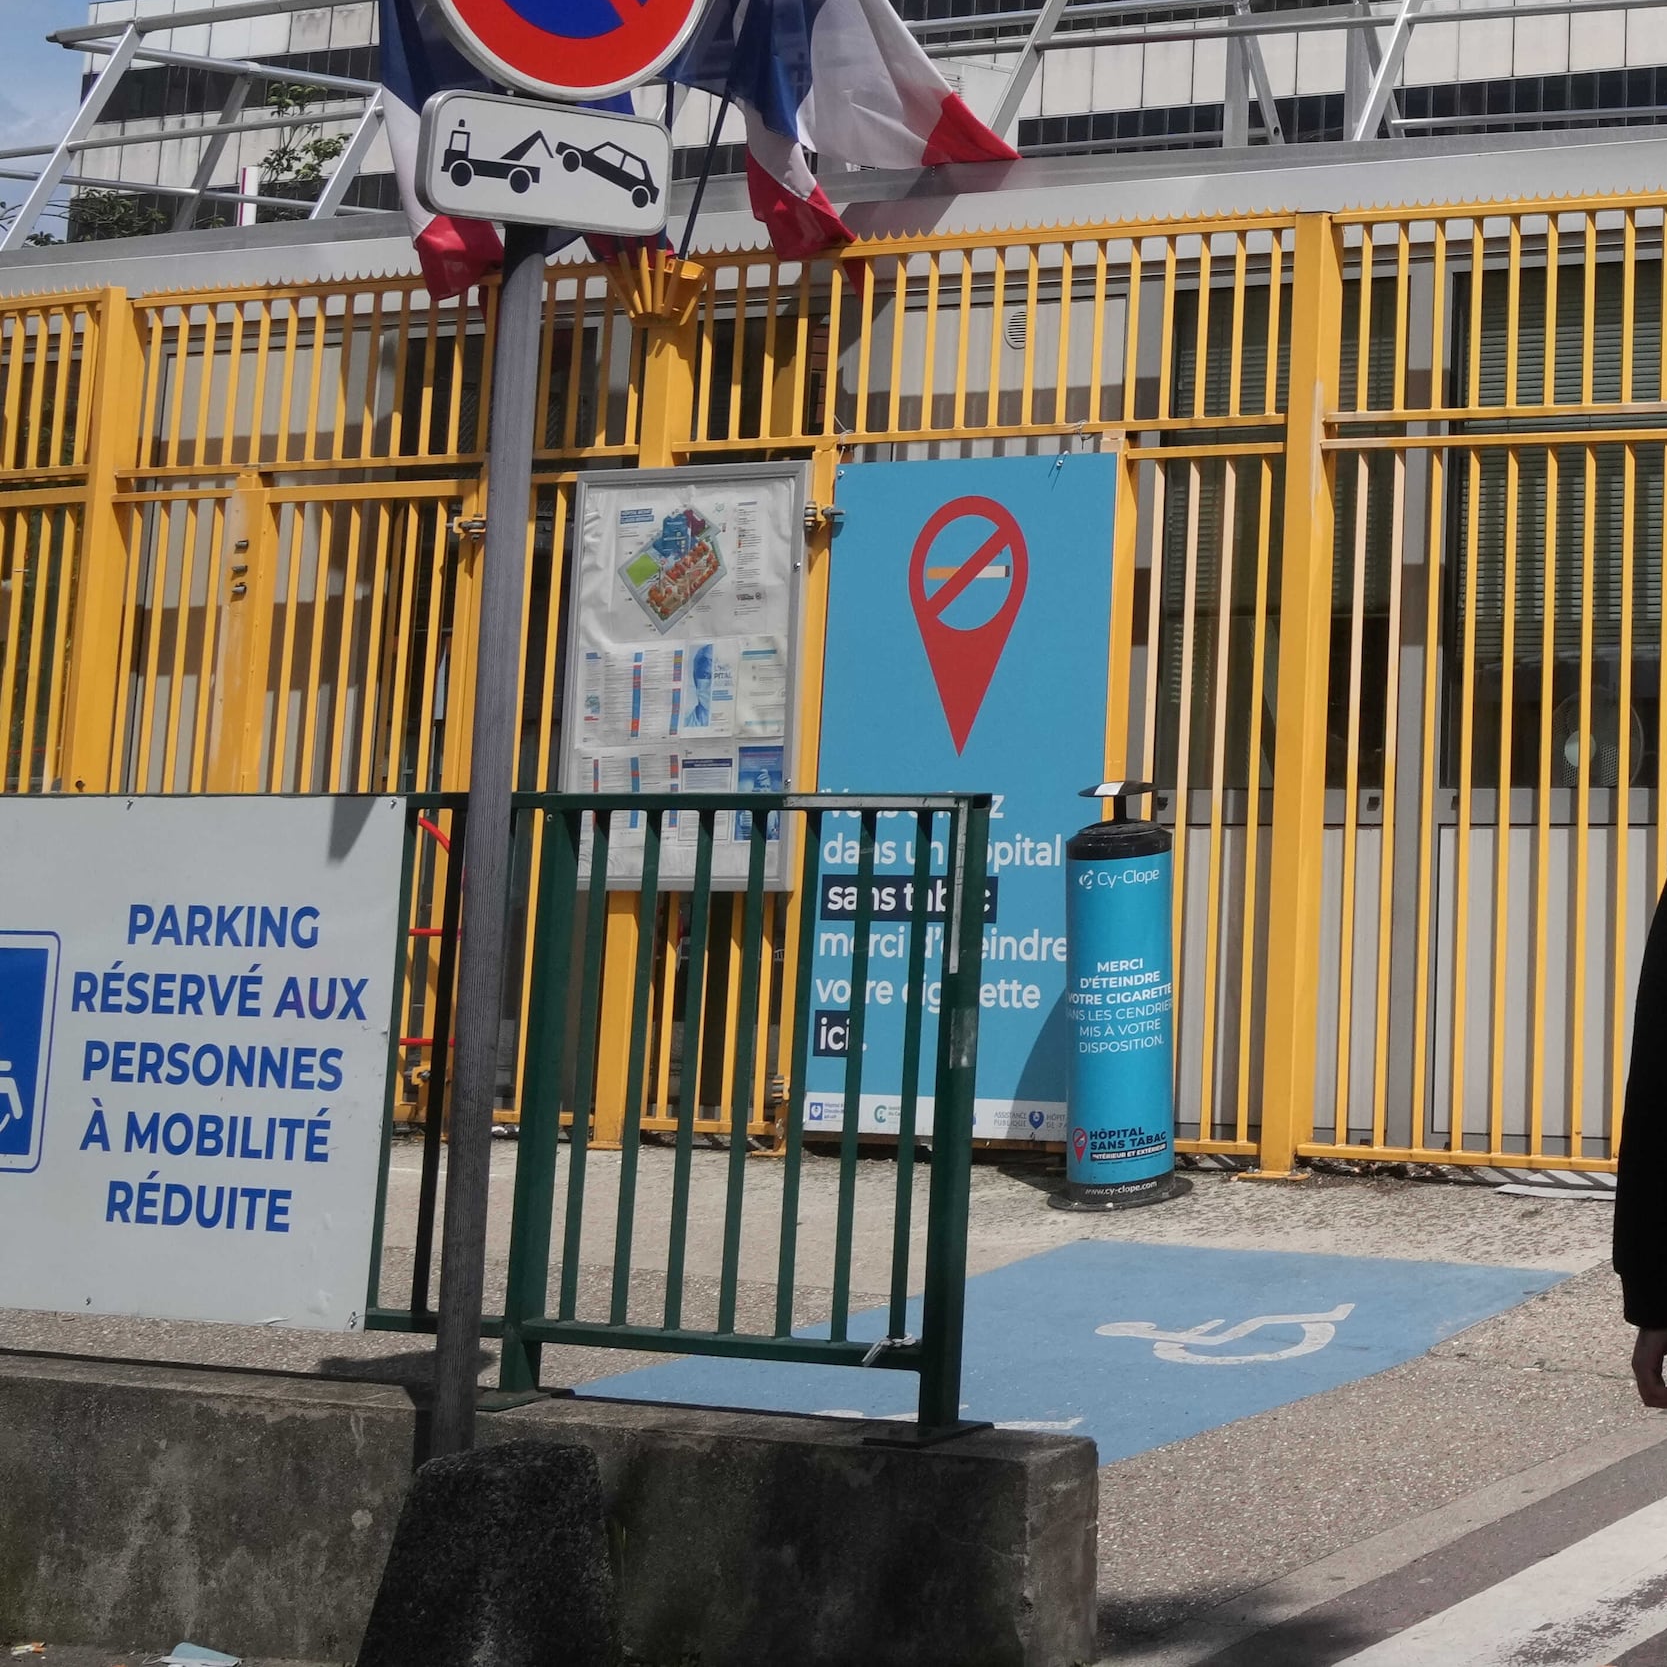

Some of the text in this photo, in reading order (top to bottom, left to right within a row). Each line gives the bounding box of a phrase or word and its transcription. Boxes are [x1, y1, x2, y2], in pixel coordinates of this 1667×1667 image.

[1097, 869, 1160, 889] Cy-Clope
[127, 904, 321, 949] PARKING
[1097, 958, 1144, 973] MERCI
[1080, 970, 1160, 989] D'ÉTEINDRE
[71, 960, 369, 1020] RÉSERVÉ AUX
[815, 979, 894, 1005] vore
[1106, 982, 1172, 1005] CIGARETTE
[1088, 1009, 1112, 1021] LES
[1079, 1018, 1161, 1038] MIS À VOTRE
[1079, 1034, 1164, 1053] DISPOSITION.
[82, 1040, 343, 1091] PERSONNES
[79, 1097, 331, 1163] À MOBILITÉ
[1089, 1127, 1145, 1140] HÔPITAL
[1090, 1131, 1167, 1151] SANS TABAC
[1127, 1150, 1136, 1158] ET
[1085, 1181, 1158, 1195] www.cy-clope.com
[105, 1170, 292, 1232] RÉDUITE
